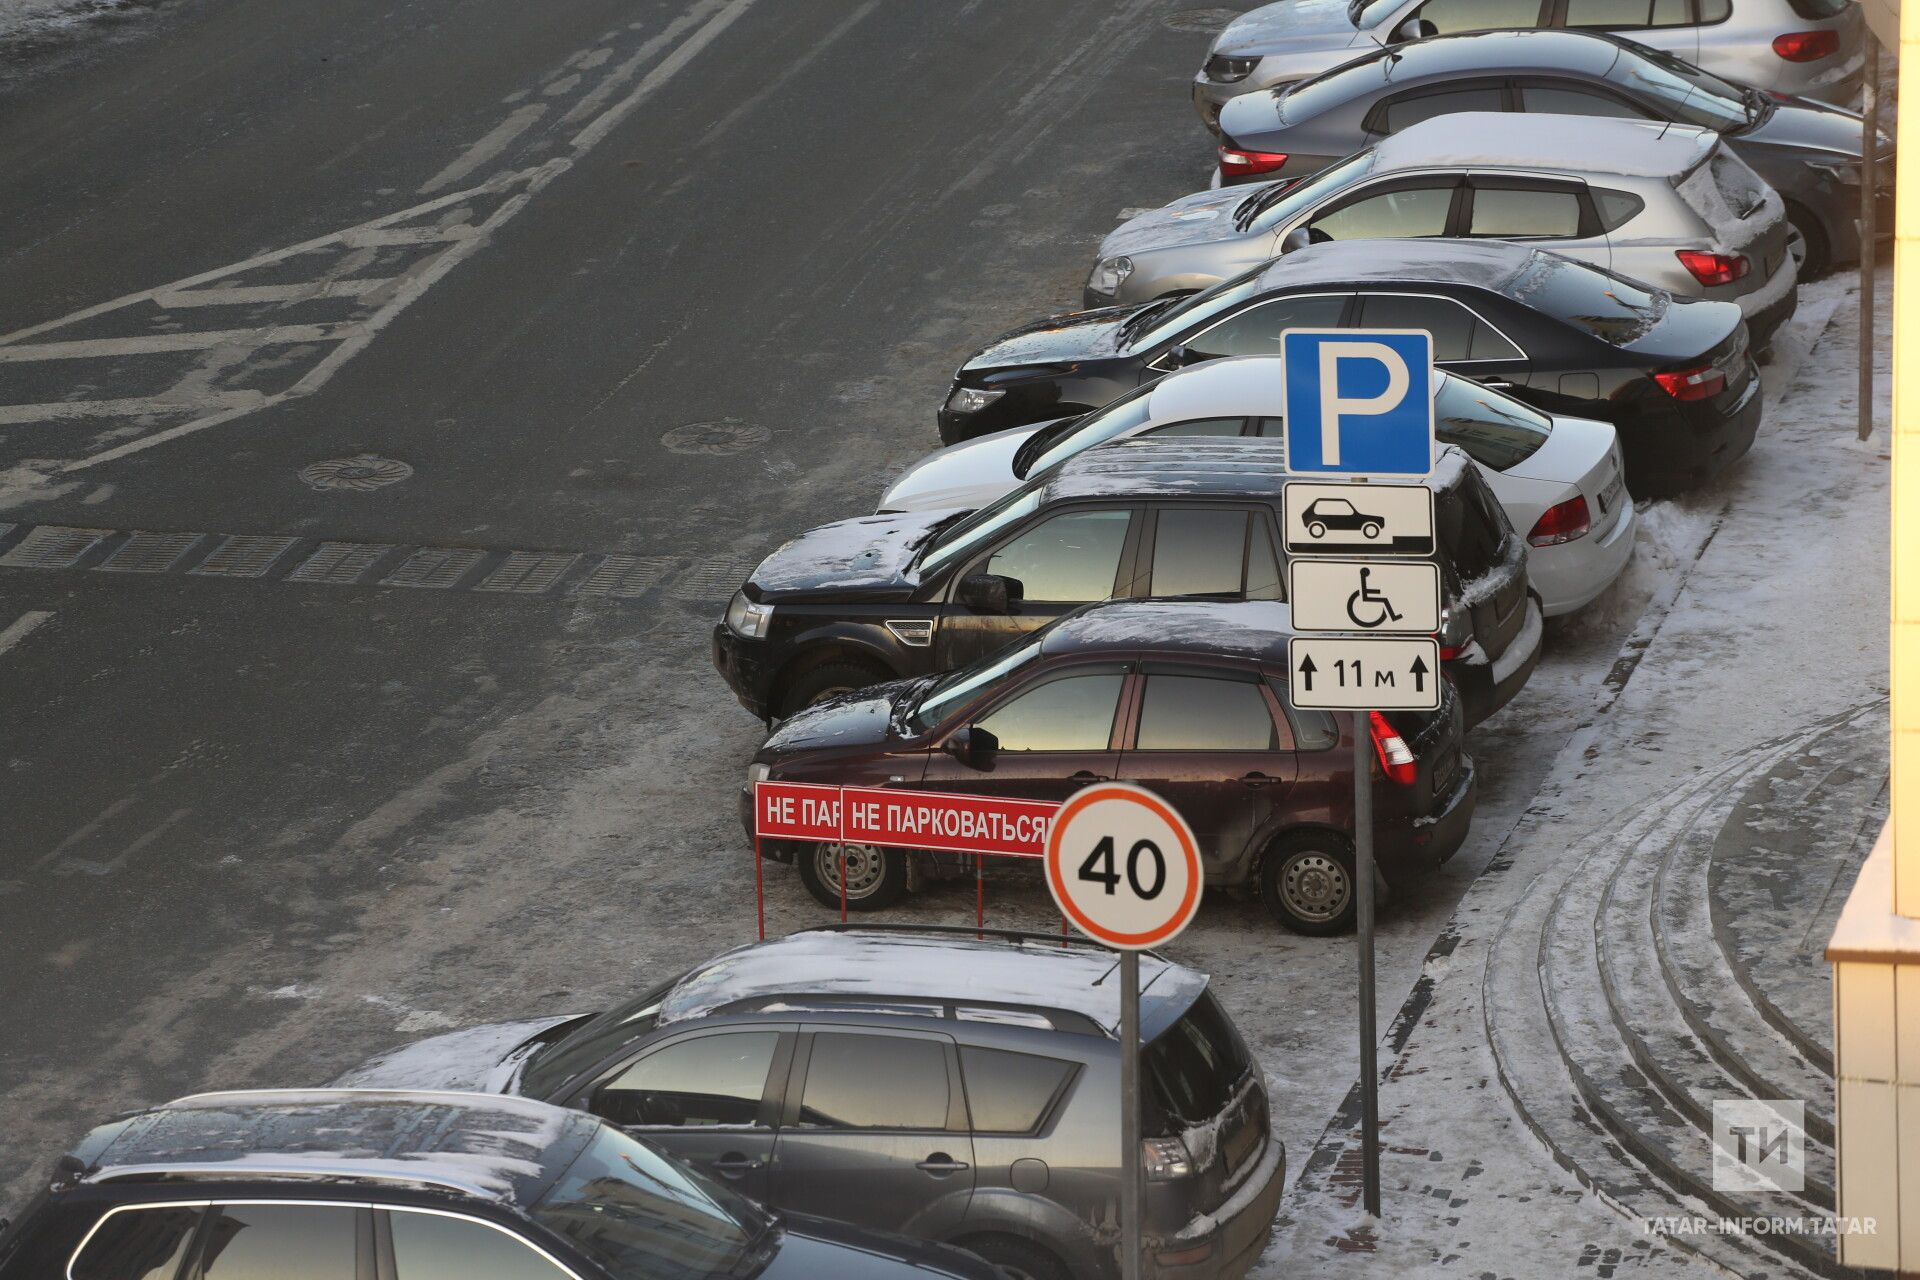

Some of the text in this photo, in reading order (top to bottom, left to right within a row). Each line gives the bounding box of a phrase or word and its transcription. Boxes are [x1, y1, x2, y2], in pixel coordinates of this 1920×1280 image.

[1318, 341, 1410, 466] P
[1333, 659, 1363, 688] 11
[767, 796, 796, 825] НЕ
[852, 802, 1053, 844] НЕ ПАРКОВАТЬСЯ
[1078, 836, 1167, 901] 40
